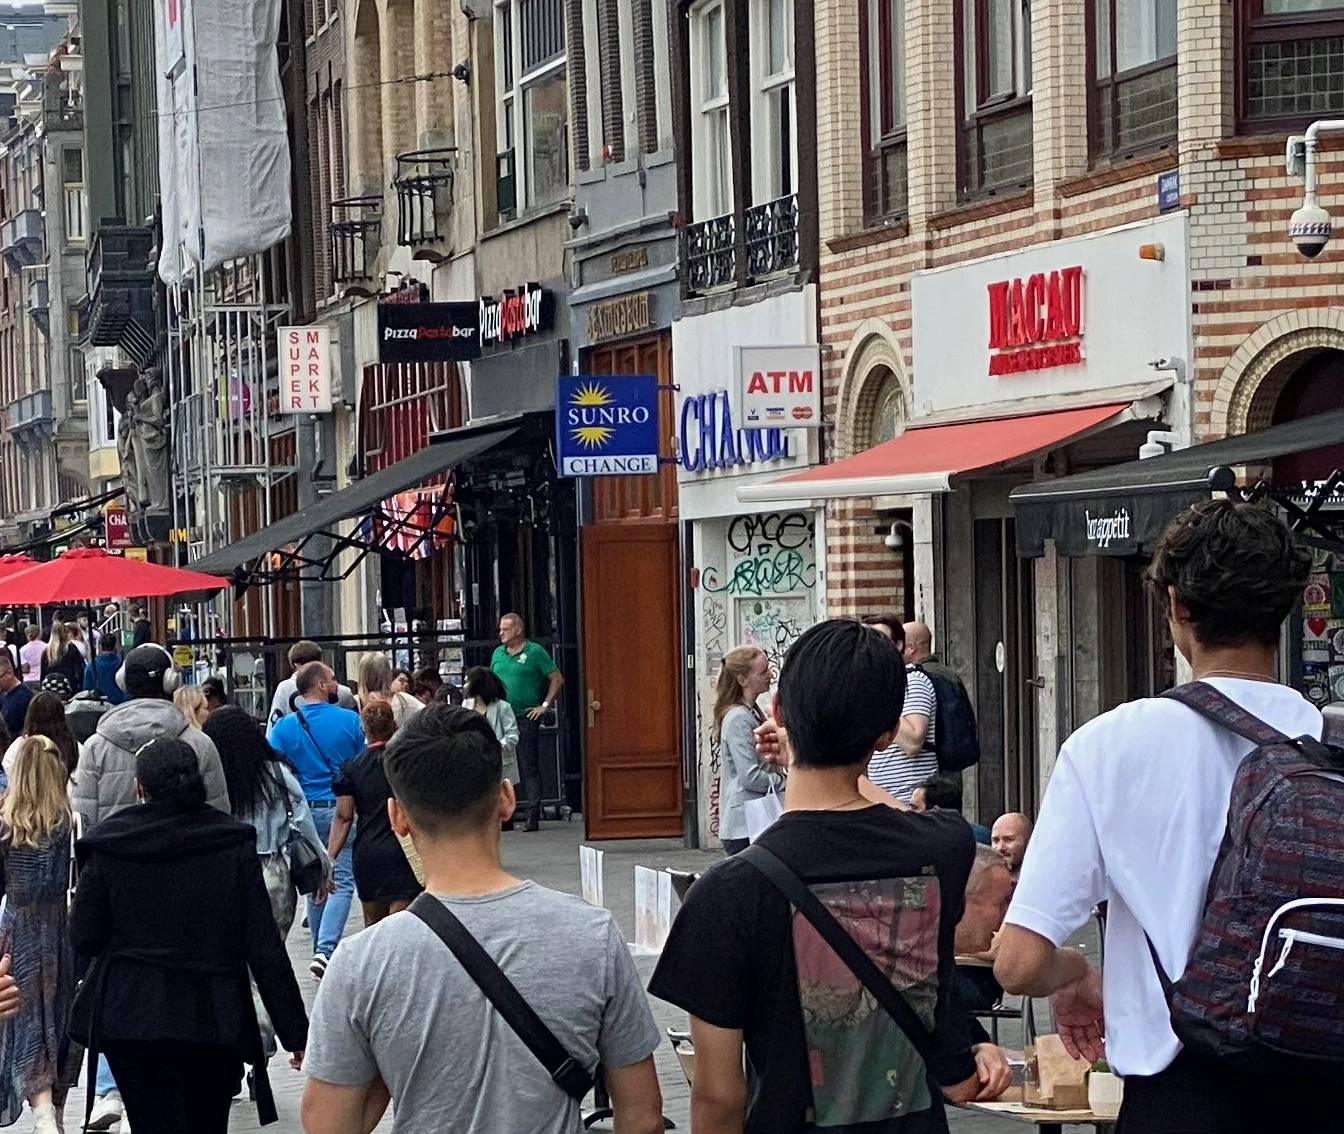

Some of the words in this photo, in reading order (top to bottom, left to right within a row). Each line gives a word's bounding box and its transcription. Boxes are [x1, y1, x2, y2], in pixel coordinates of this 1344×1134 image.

[289, 331, 302, 409] SUPER
[306, 331, 320, 409] MARKT
[747, 371, 813, 394] ATM
[568, 407, 649, 425] SUNRO
[570, 457, 651, 474] CHANGE
